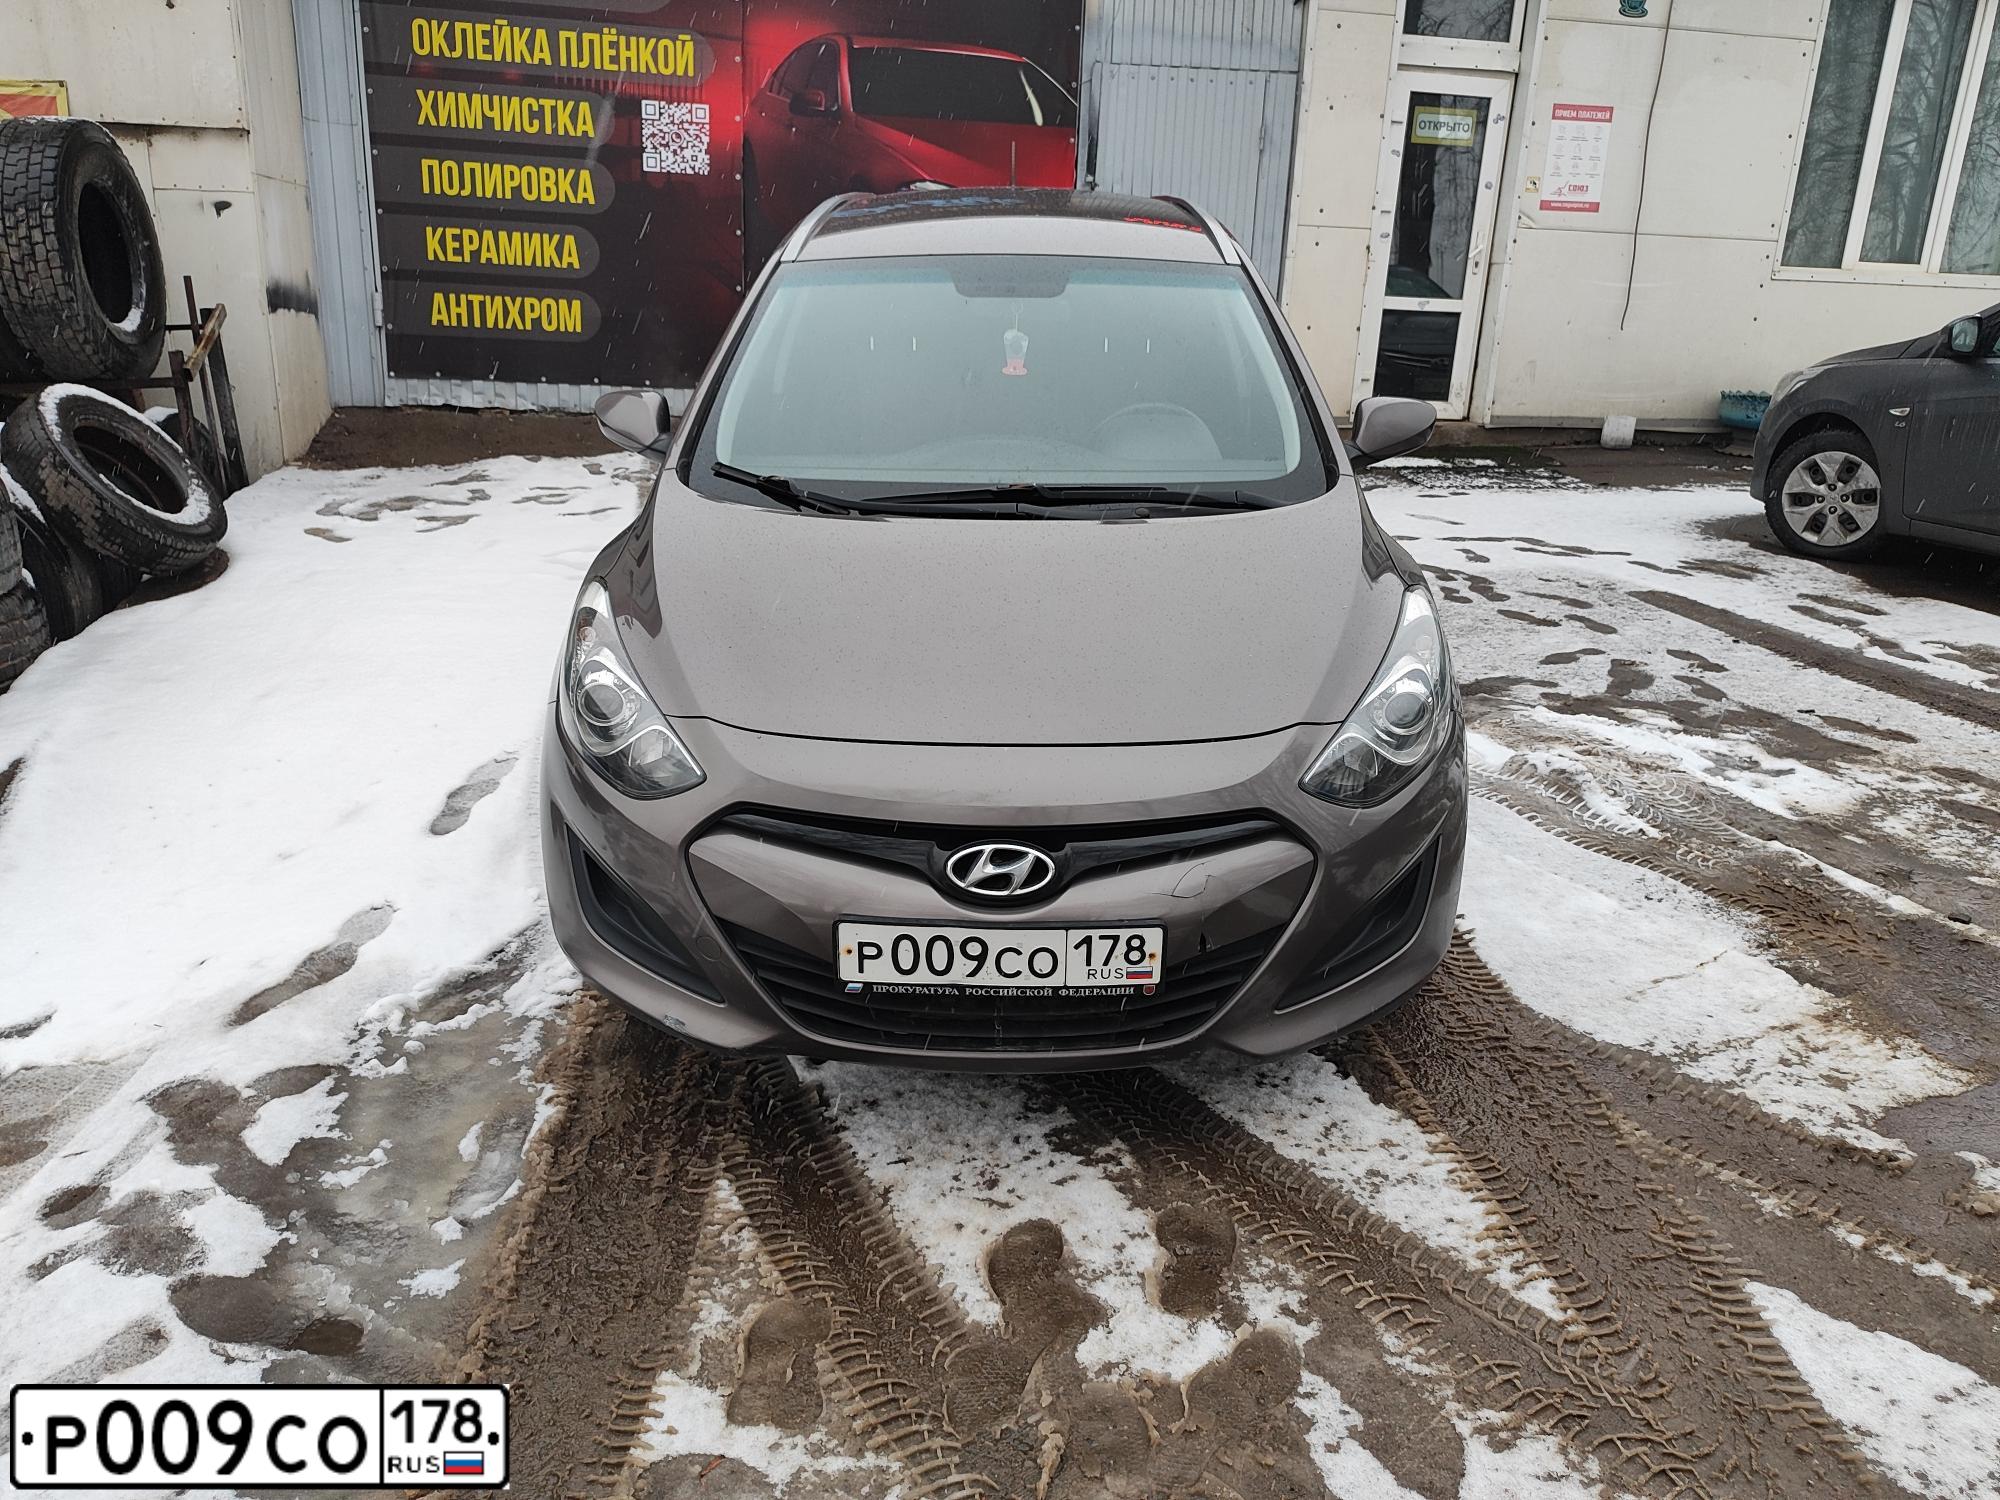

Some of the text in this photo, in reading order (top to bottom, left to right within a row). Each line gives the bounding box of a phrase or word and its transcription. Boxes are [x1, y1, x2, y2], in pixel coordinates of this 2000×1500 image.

[411, 17, 695, 77] ОКЛЕЙКА ПЛЁНКОЙ
[416, 89, 596, 138] ХИМЧИСТКА
[1418, 119, 1470, 133] ОТКРЫТО
[1554, 108, 1611, 120] ПРИЕМ ПЛАТЕЖЕЙ
[420, 158, 596, 205] ПОЛИРОВКА
[1568, 183, 1589, 193] СОЮЗ
[425, 226, 581, 270] КЕРАМИКА
[431, 292, 583, 333] АНТИХРОМ
[1072, 934, 1147, 967] 178
[1086, 968, 1124, 980] RUS
[872, 985, 1135, 997] ПРОКУРАТУРА РОССИЙСКОЙ ФЕДЕРАЦИИ
